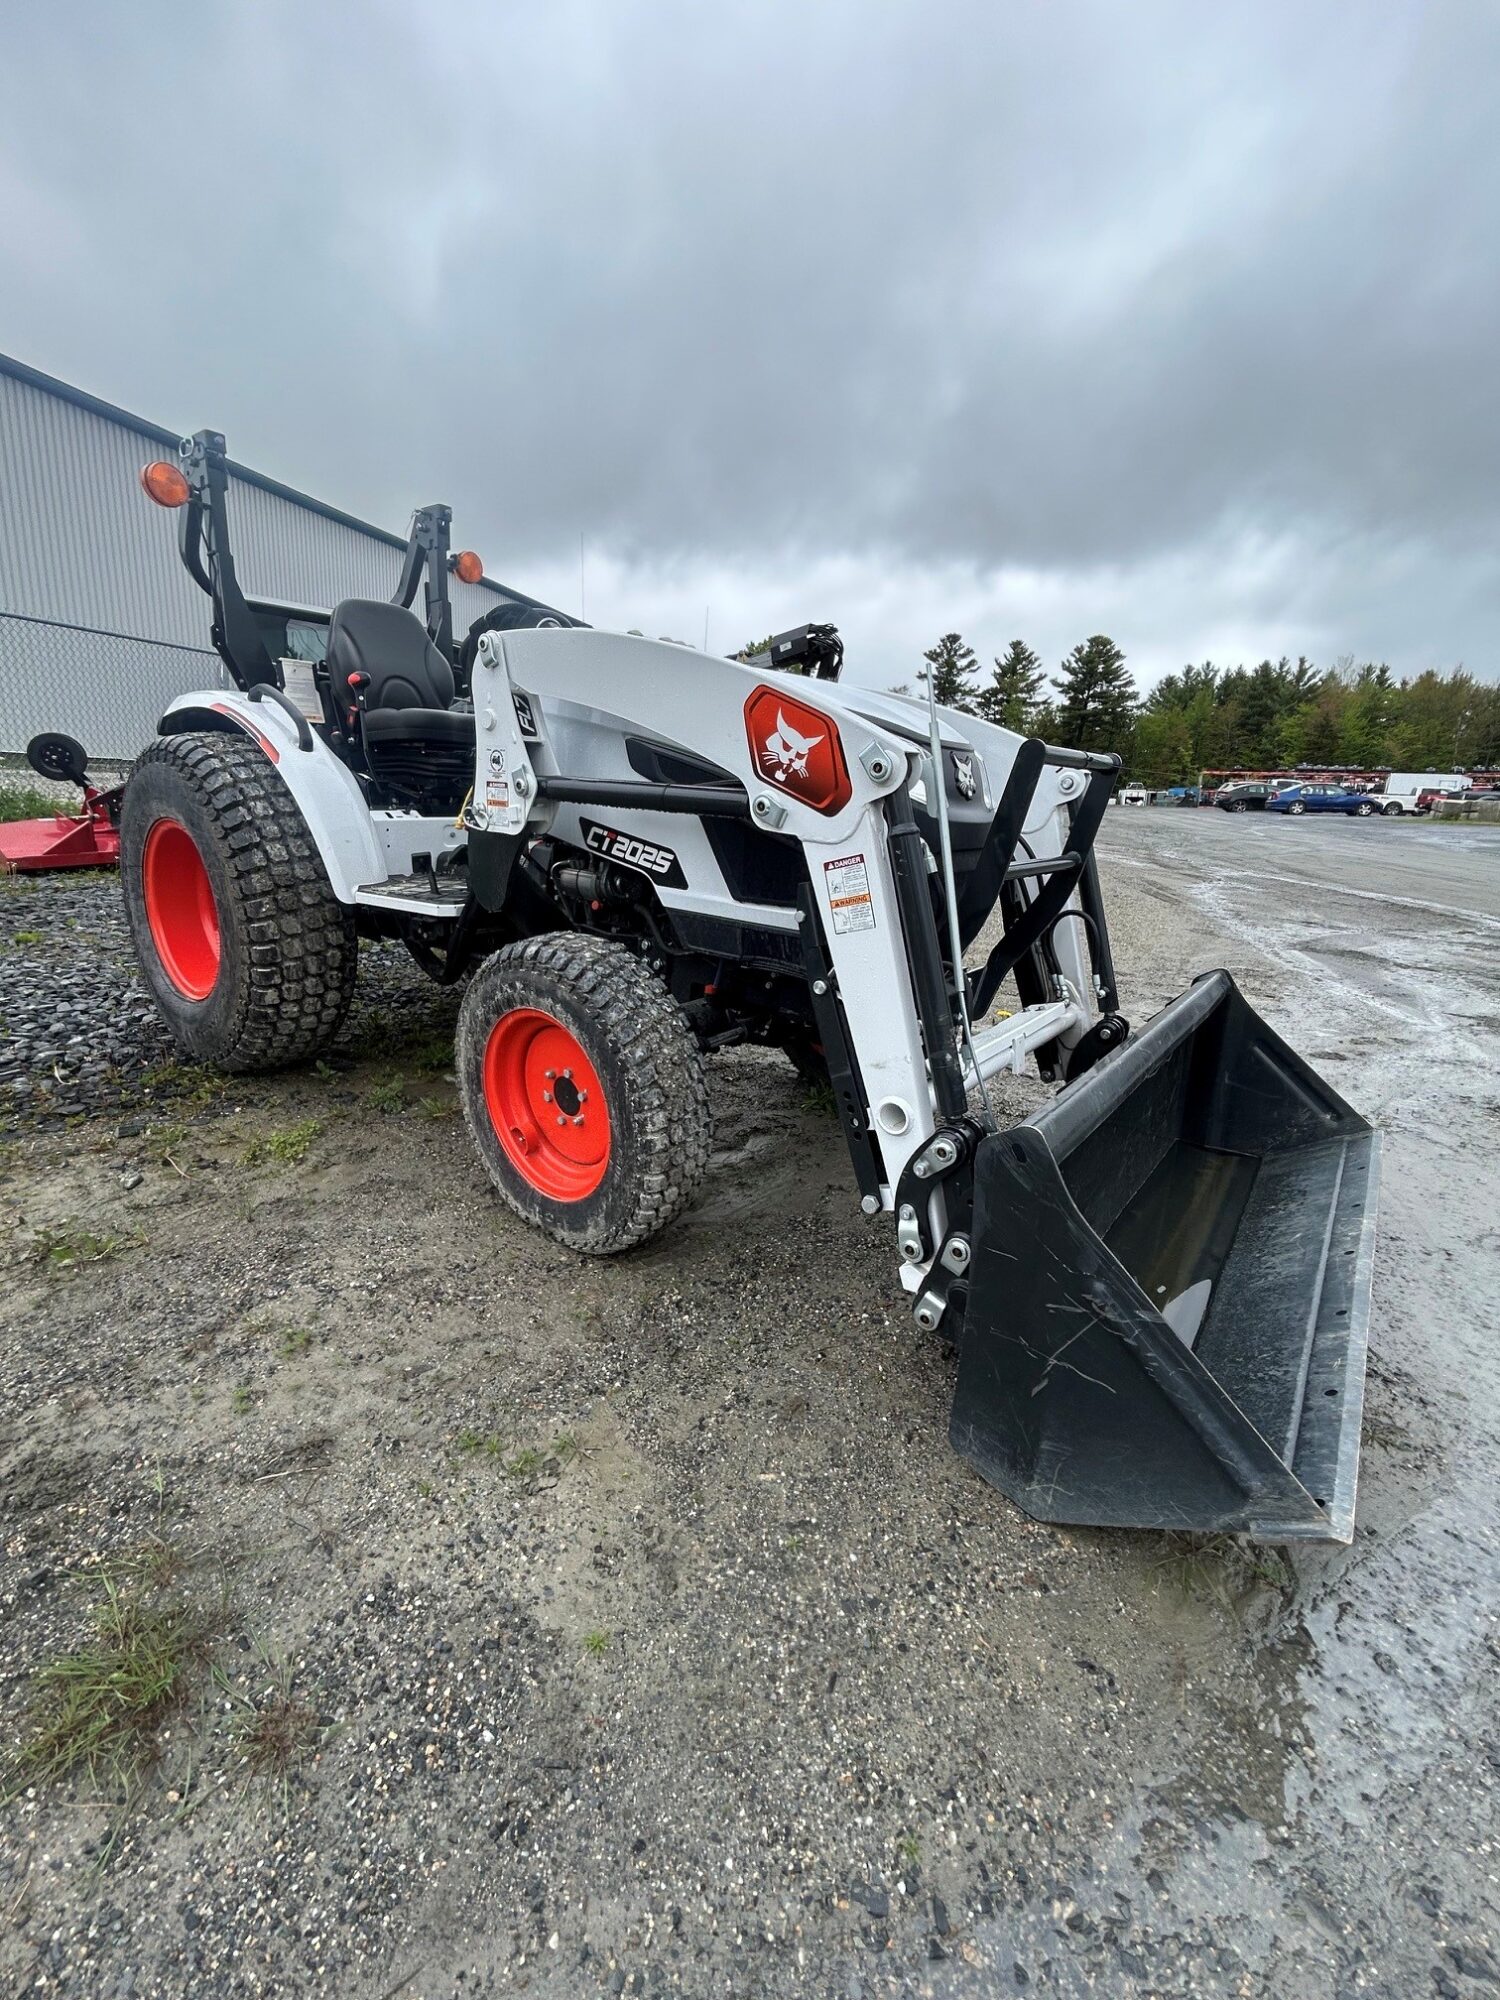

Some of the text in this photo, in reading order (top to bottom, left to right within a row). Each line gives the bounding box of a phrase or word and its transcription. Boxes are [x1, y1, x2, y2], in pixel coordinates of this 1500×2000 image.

[513, 694, 535, 732] FL7
[586, 826, 675, 874] CT2025
[834, 856, 861, 868] DANGER
[840, 895, 867, 906] WARNING
